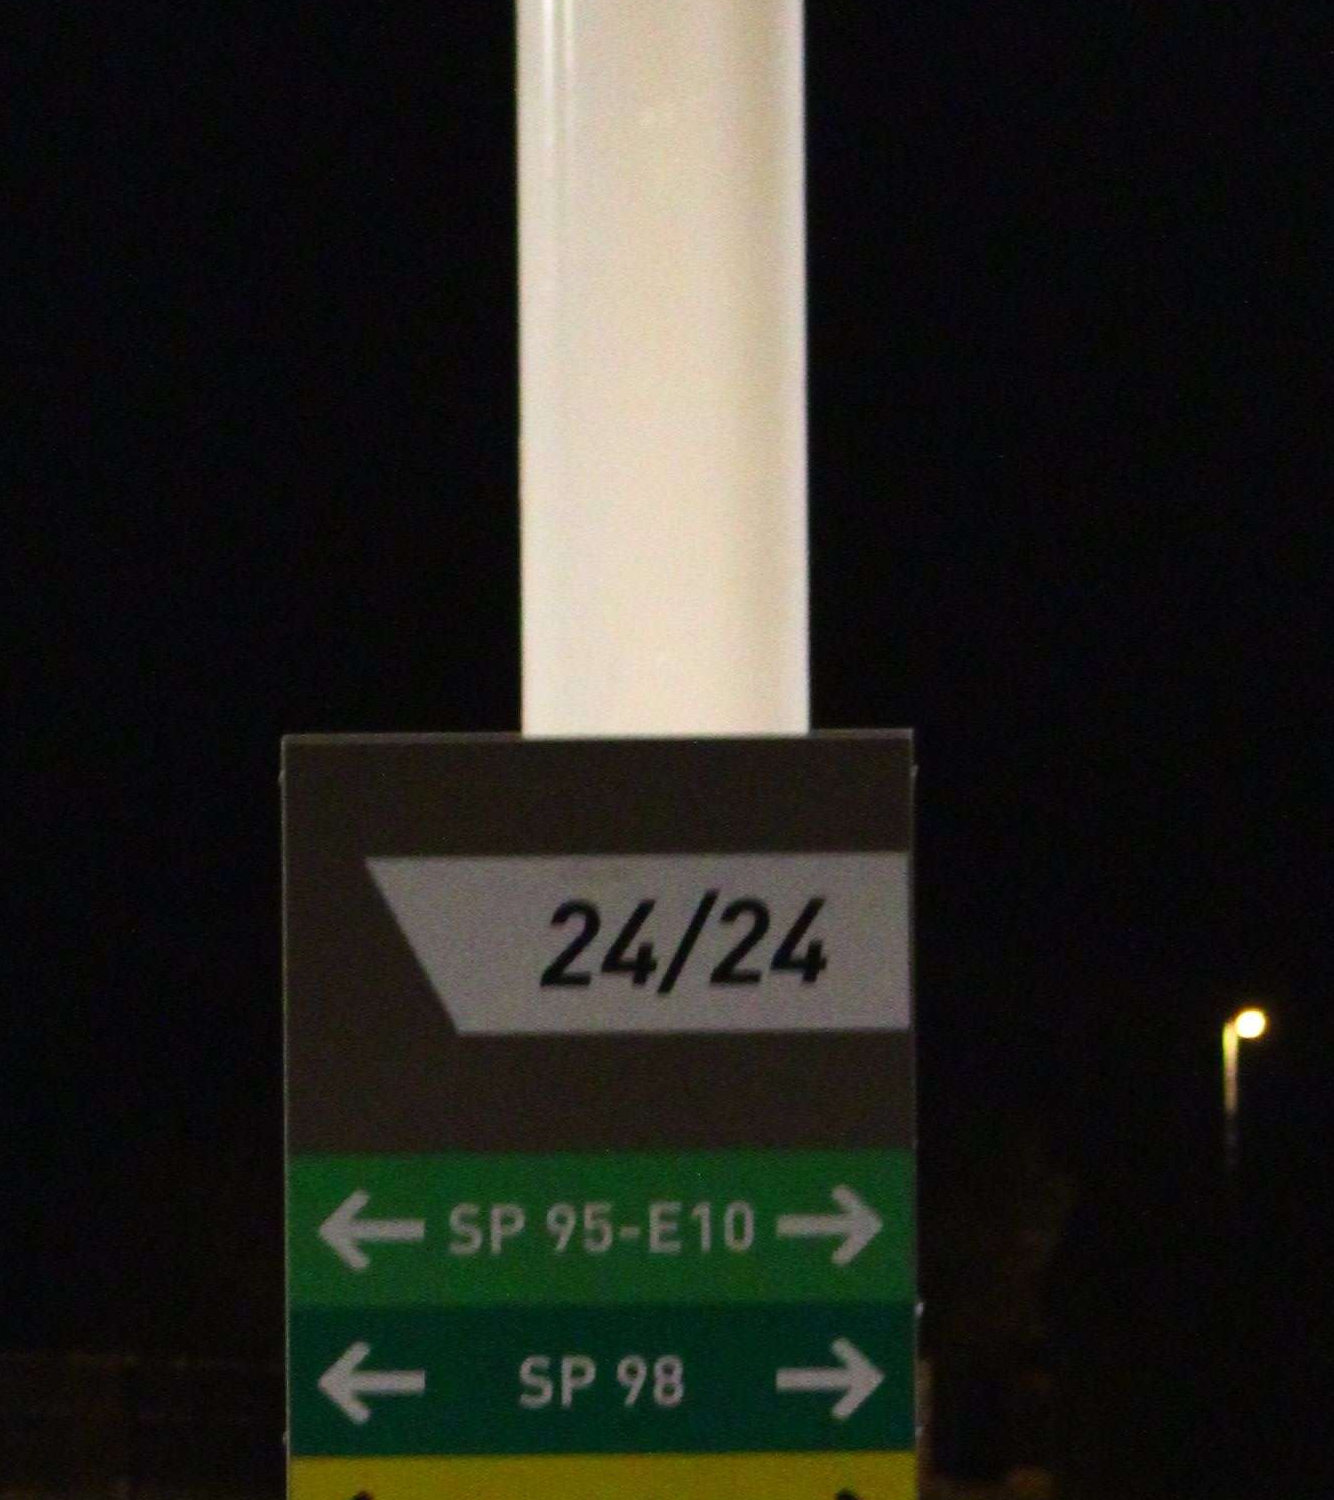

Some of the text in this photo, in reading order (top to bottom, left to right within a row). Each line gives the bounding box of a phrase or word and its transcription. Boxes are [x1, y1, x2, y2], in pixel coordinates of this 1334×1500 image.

[539, 889, 829, 996] 24/24
[448, 1200, 756, 1256] SP 95-E10
[519, 1354, 685, 1409] SP 98
